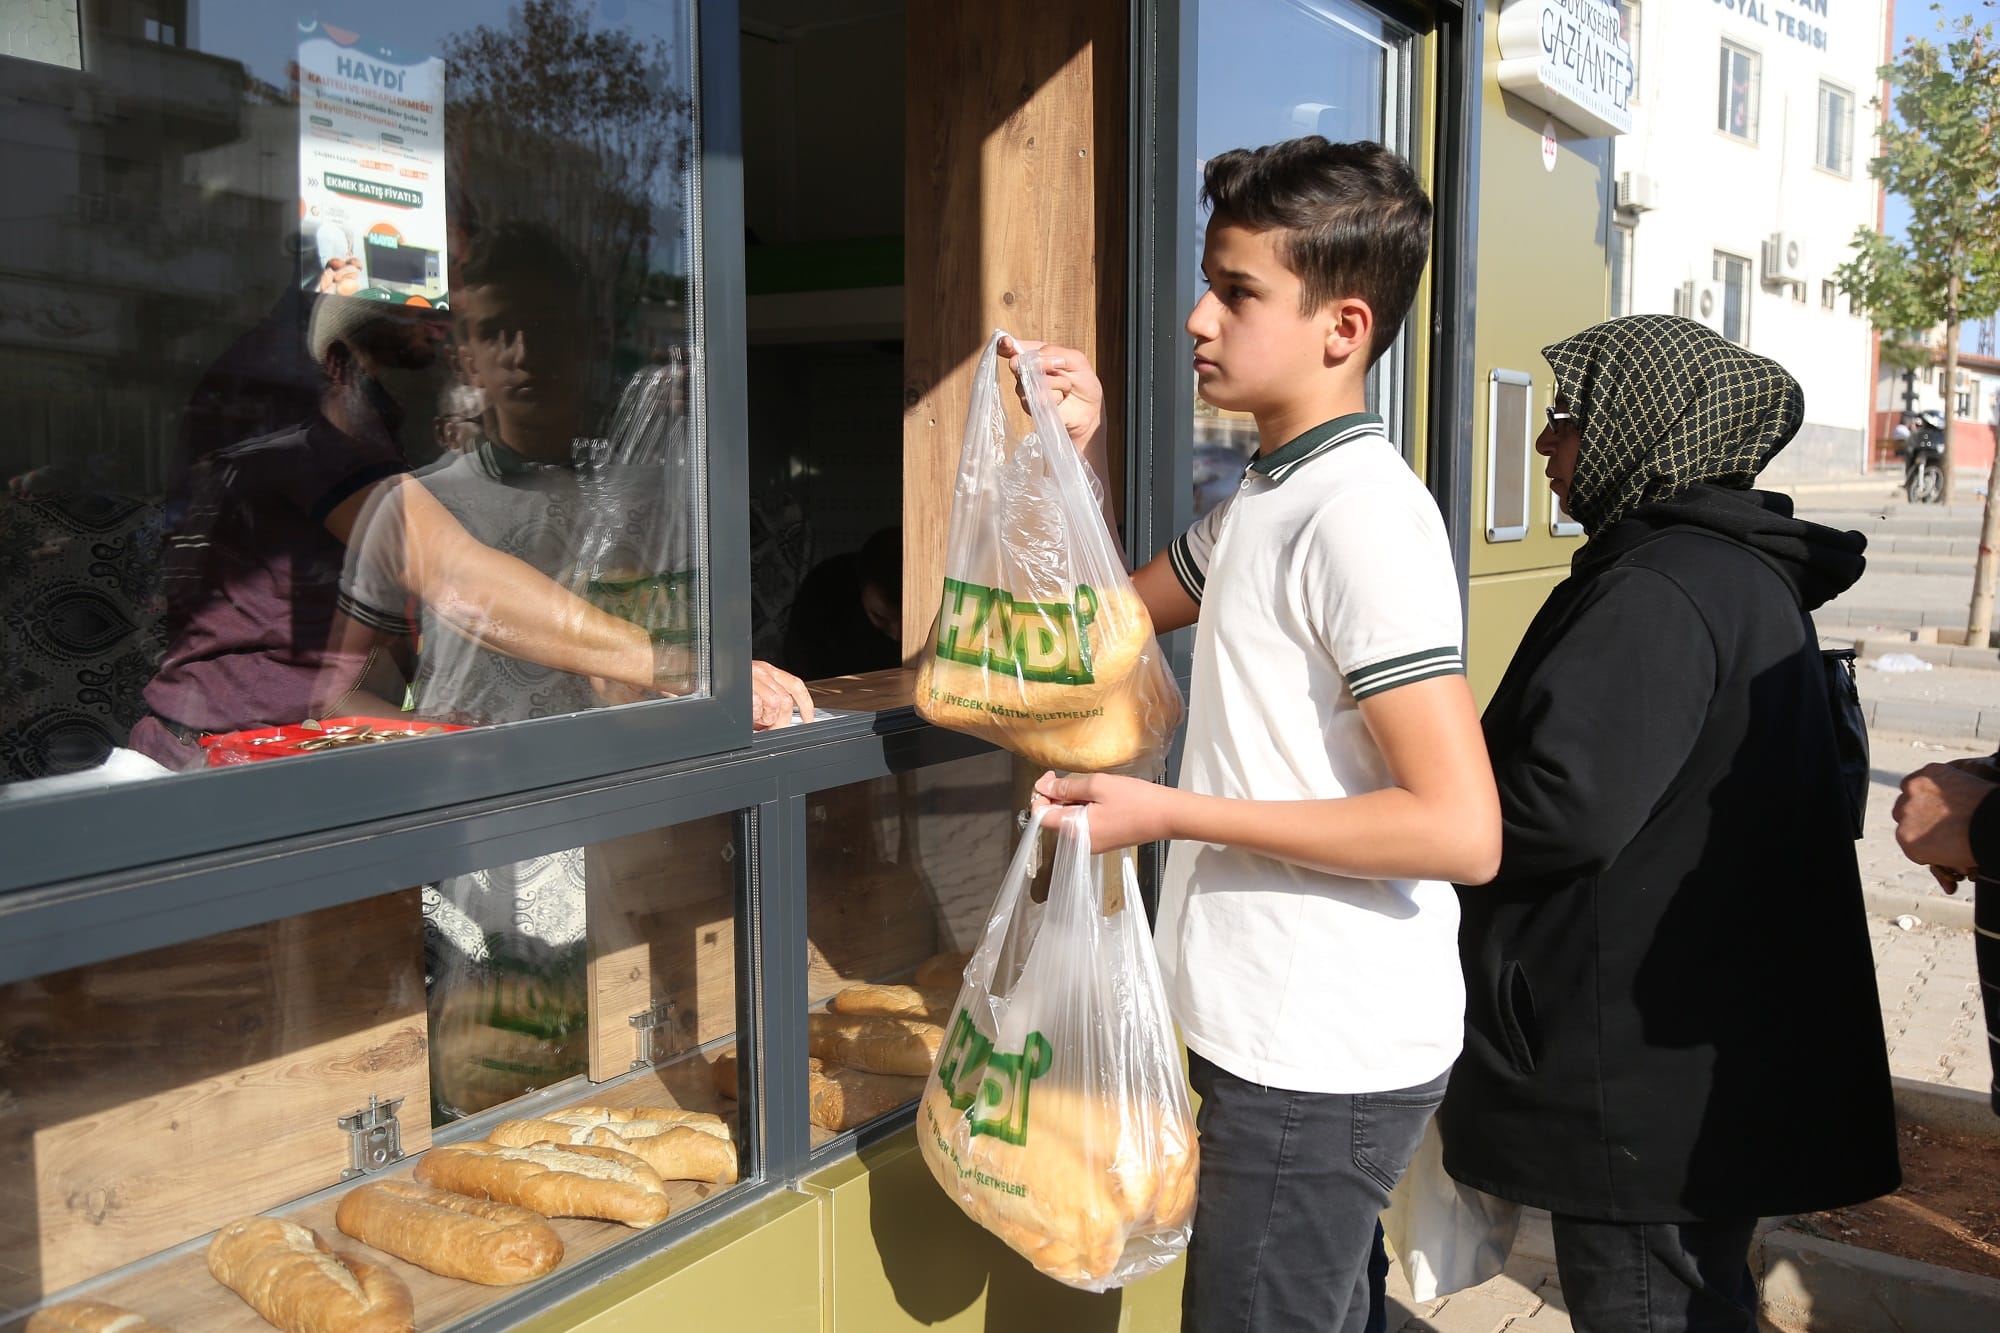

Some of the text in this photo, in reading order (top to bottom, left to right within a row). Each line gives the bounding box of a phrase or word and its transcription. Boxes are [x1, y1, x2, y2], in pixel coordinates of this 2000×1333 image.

[337, 55, 406, 92] HAYDİ
[326, 175, 358, 191] EKMEK
[358, 181, 383, 199] SATIŞ
[384, 187, 411, 202] FİYATI
